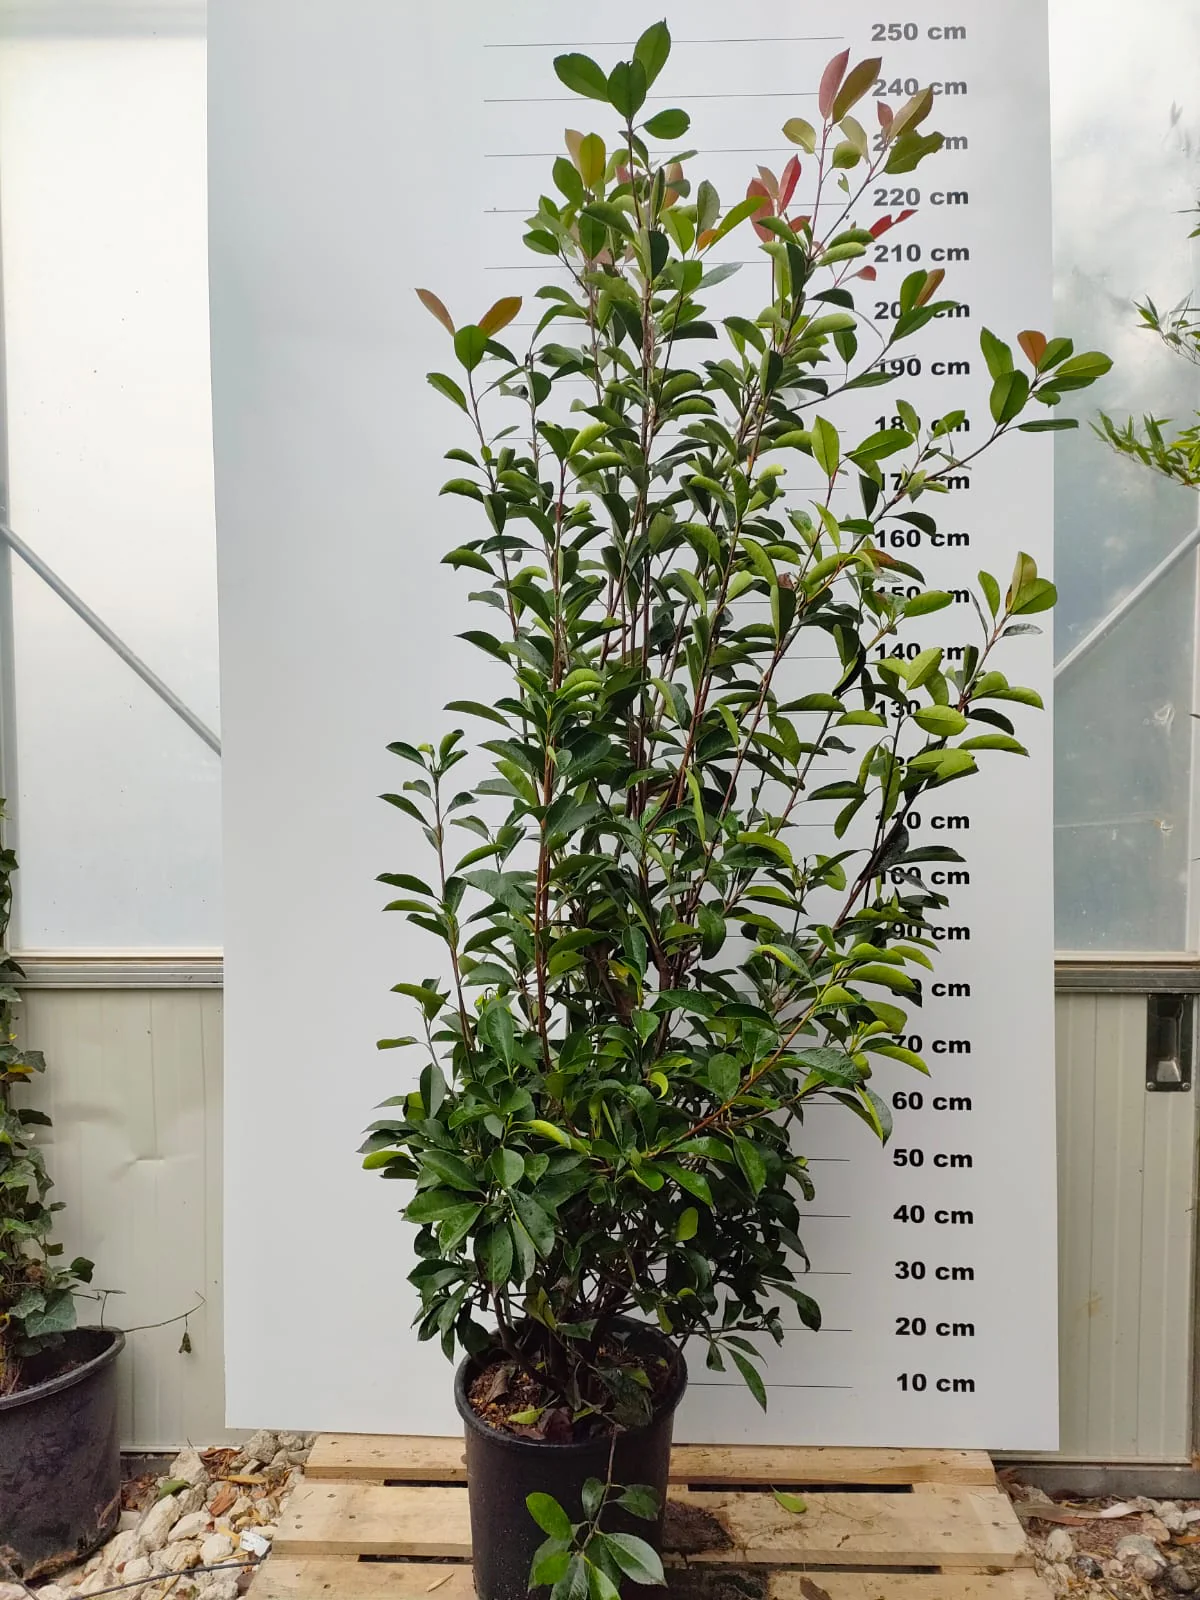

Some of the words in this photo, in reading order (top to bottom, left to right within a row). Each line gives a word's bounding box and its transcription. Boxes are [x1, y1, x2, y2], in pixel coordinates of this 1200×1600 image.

[871, 22, 919, 42] 250
[927, 25, 966, 40] cm
[872, 78, 919, 97] 240
[940, 136, 968, 150] m
[873, 188, 920, 206] 220
[930, 190, 969, 205] cm
[874, 244, 921, 262] 210
[930, 247, 970, 261] cm
[874, 301, 906, 320] 20
[875, 358, 921, 376] 190
[931, 361, 970, 375] cm
[874, 416, 921, 431] 18
[940, 475, 970, 489] m
[874, 529, 921, 548] 160
[930, 532, 970, 546] cm
[938, 589, 970, 603] m
[874, 643, 921, 660] 140
[931, 815, 970, 829] cm
[931, 869, 970, 885] cm
[892, 922, 922, 940] 90
[931, 926, 970, 940] cm
[931, 982, 971, 997] cm
[892, 1035, 923, 1053] 70
[932, 1039, 971, 1054] cm
[892, 1091, 923, 1110] 60
[933, 1096, 972, 1110] cm
[893, 1148, 924, 1167] 50
[933, 1153, 973, 1168] cm
[893, 1204, 925, 1223] 40
[934, 1209, 974, 1224] cm
[895, 1260, 926, 1280] 30
[935, 1266, 975, 1280] cm
[895, 1317, 927, 1336] 20
[936, 1322, 975, 1336] cm
[897, 1373, 927, 1391] 10
[936, 1378, 975, 1392] cm
